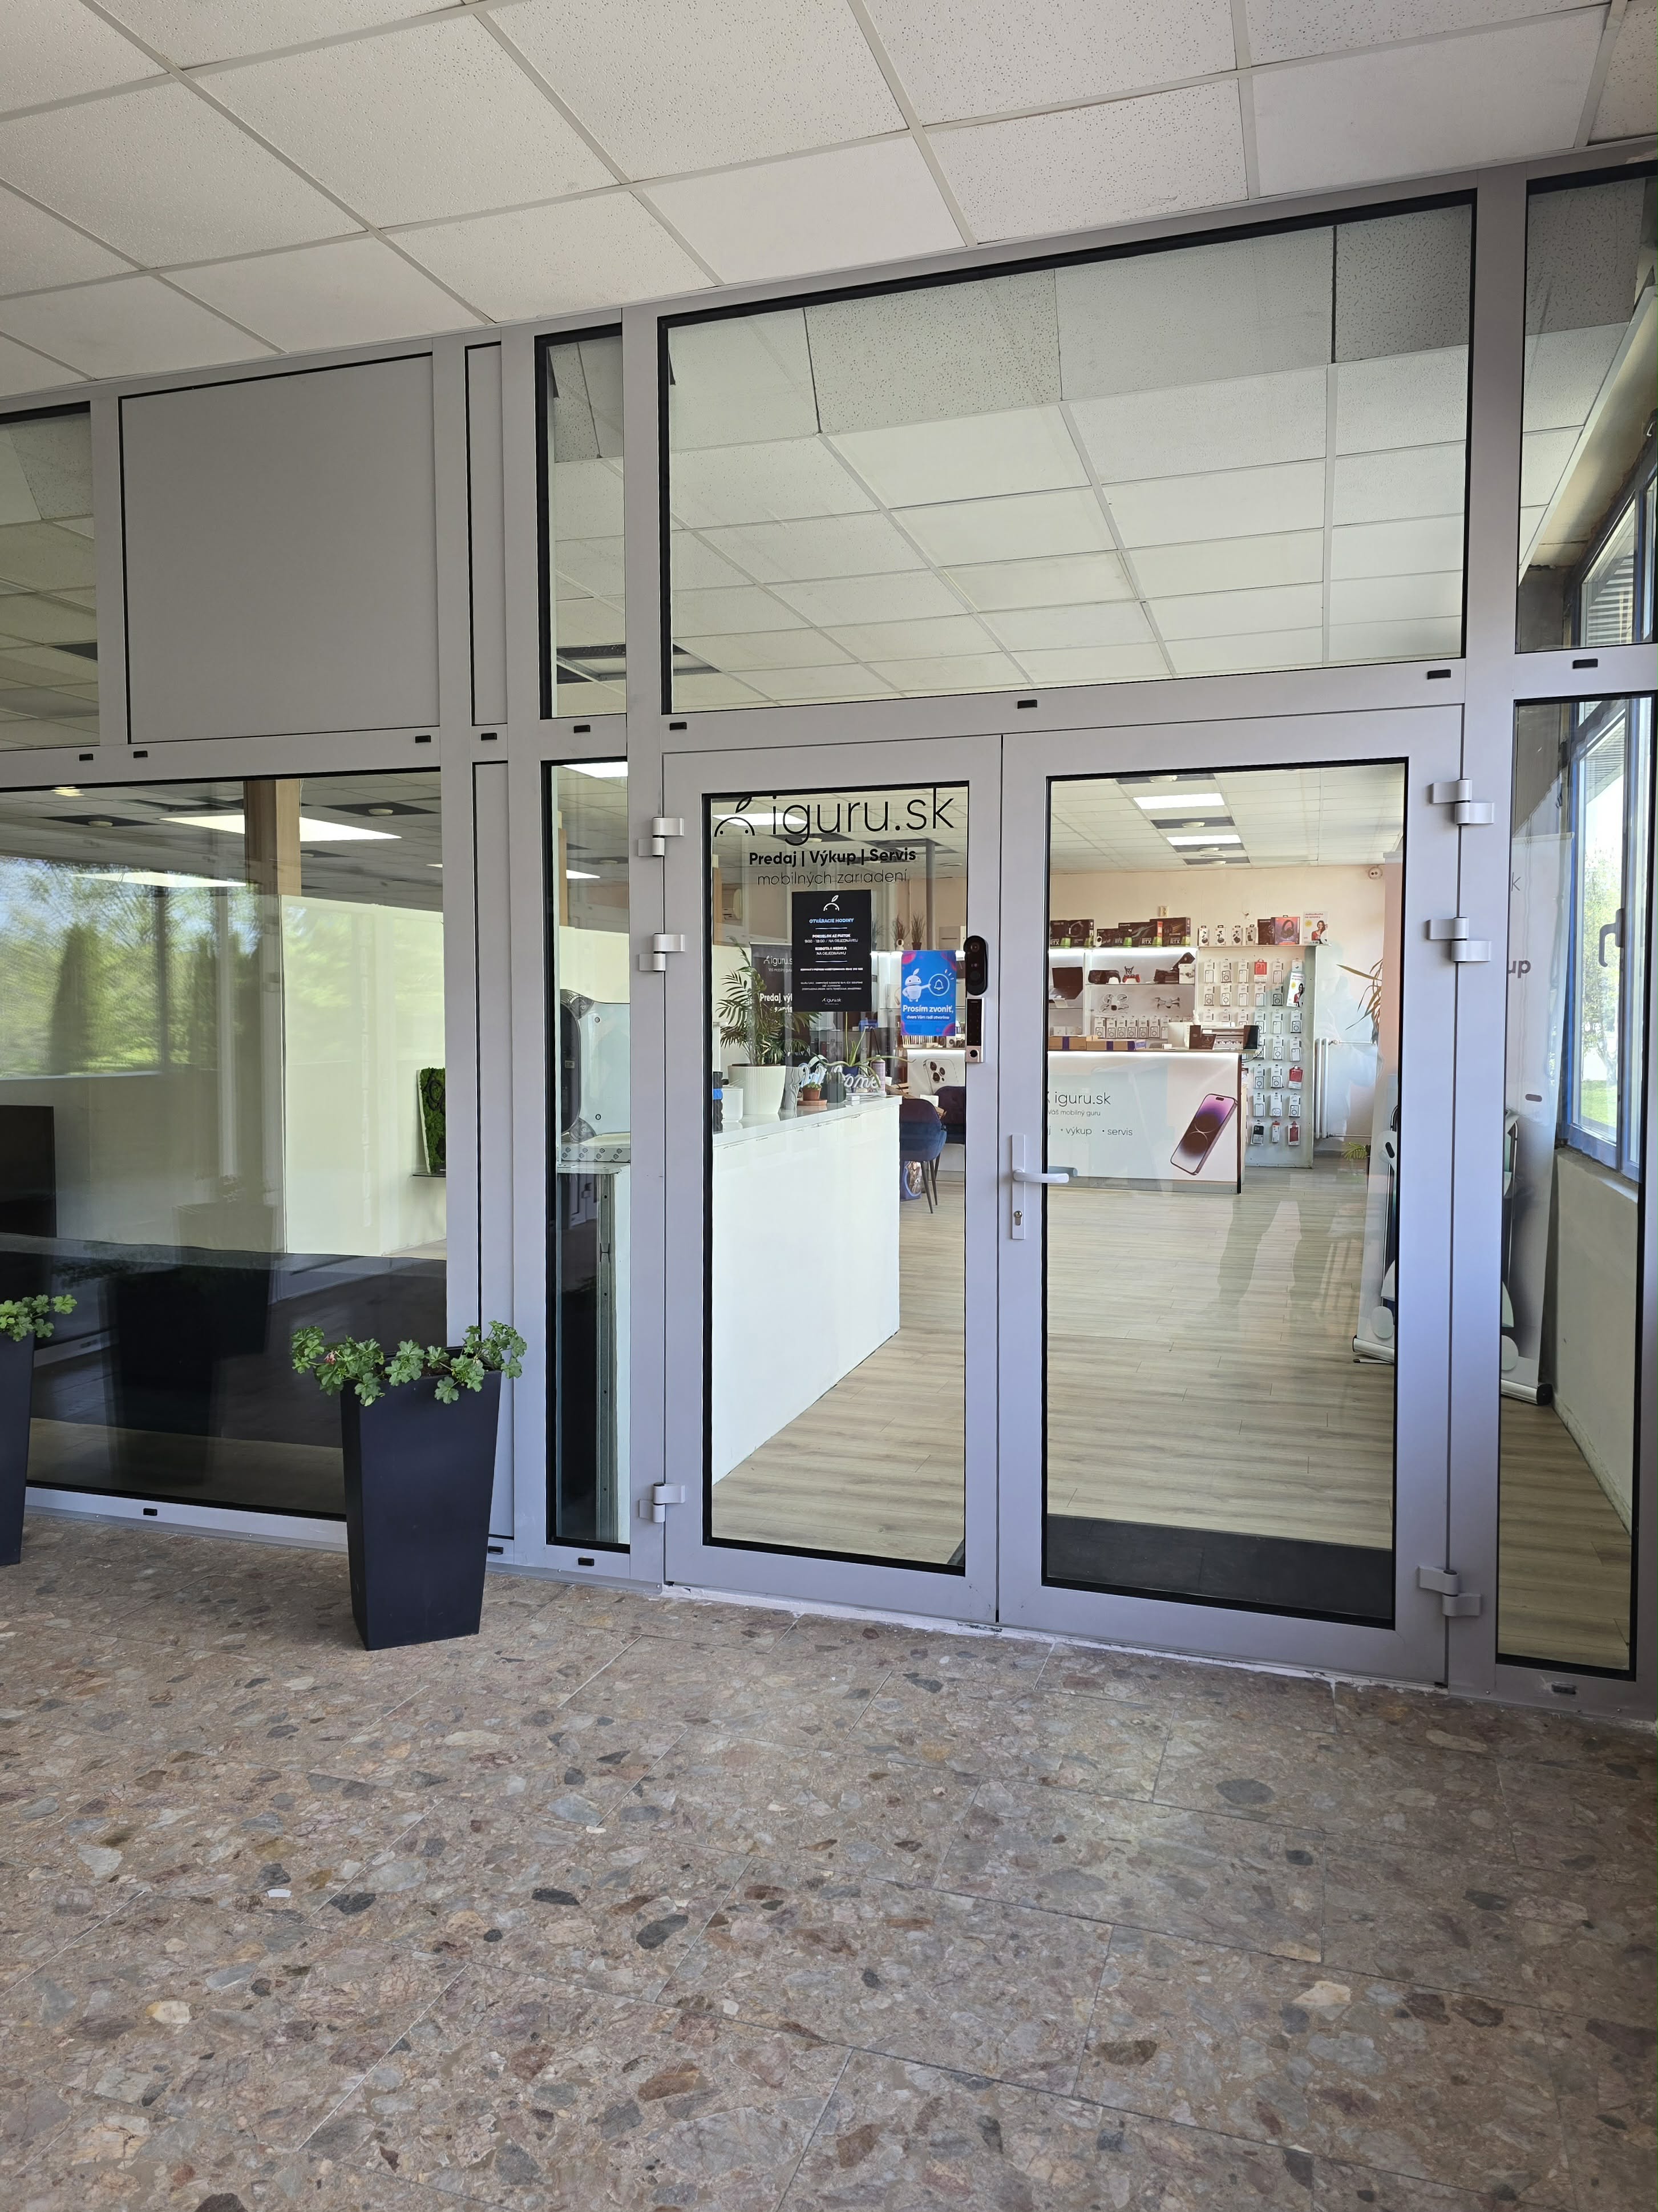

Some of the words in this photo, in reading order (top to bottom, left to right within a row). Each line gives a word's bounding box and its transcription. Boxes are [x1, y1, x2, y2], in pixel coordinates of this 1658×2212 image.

[772, 788, 955, 846] iguru.sk
[749, 852, 796, 867] Predaj
[810, 849, 856, 866] Výkup
[869, 847, 916, 862] Servis
[758, 871, 832, 887] mobilných
[837, 868, 907, 884] zariadení
[1055, 1092, 1111, 1107] iguru.sk
[1066, 1127, 1092, 1136] výkup
